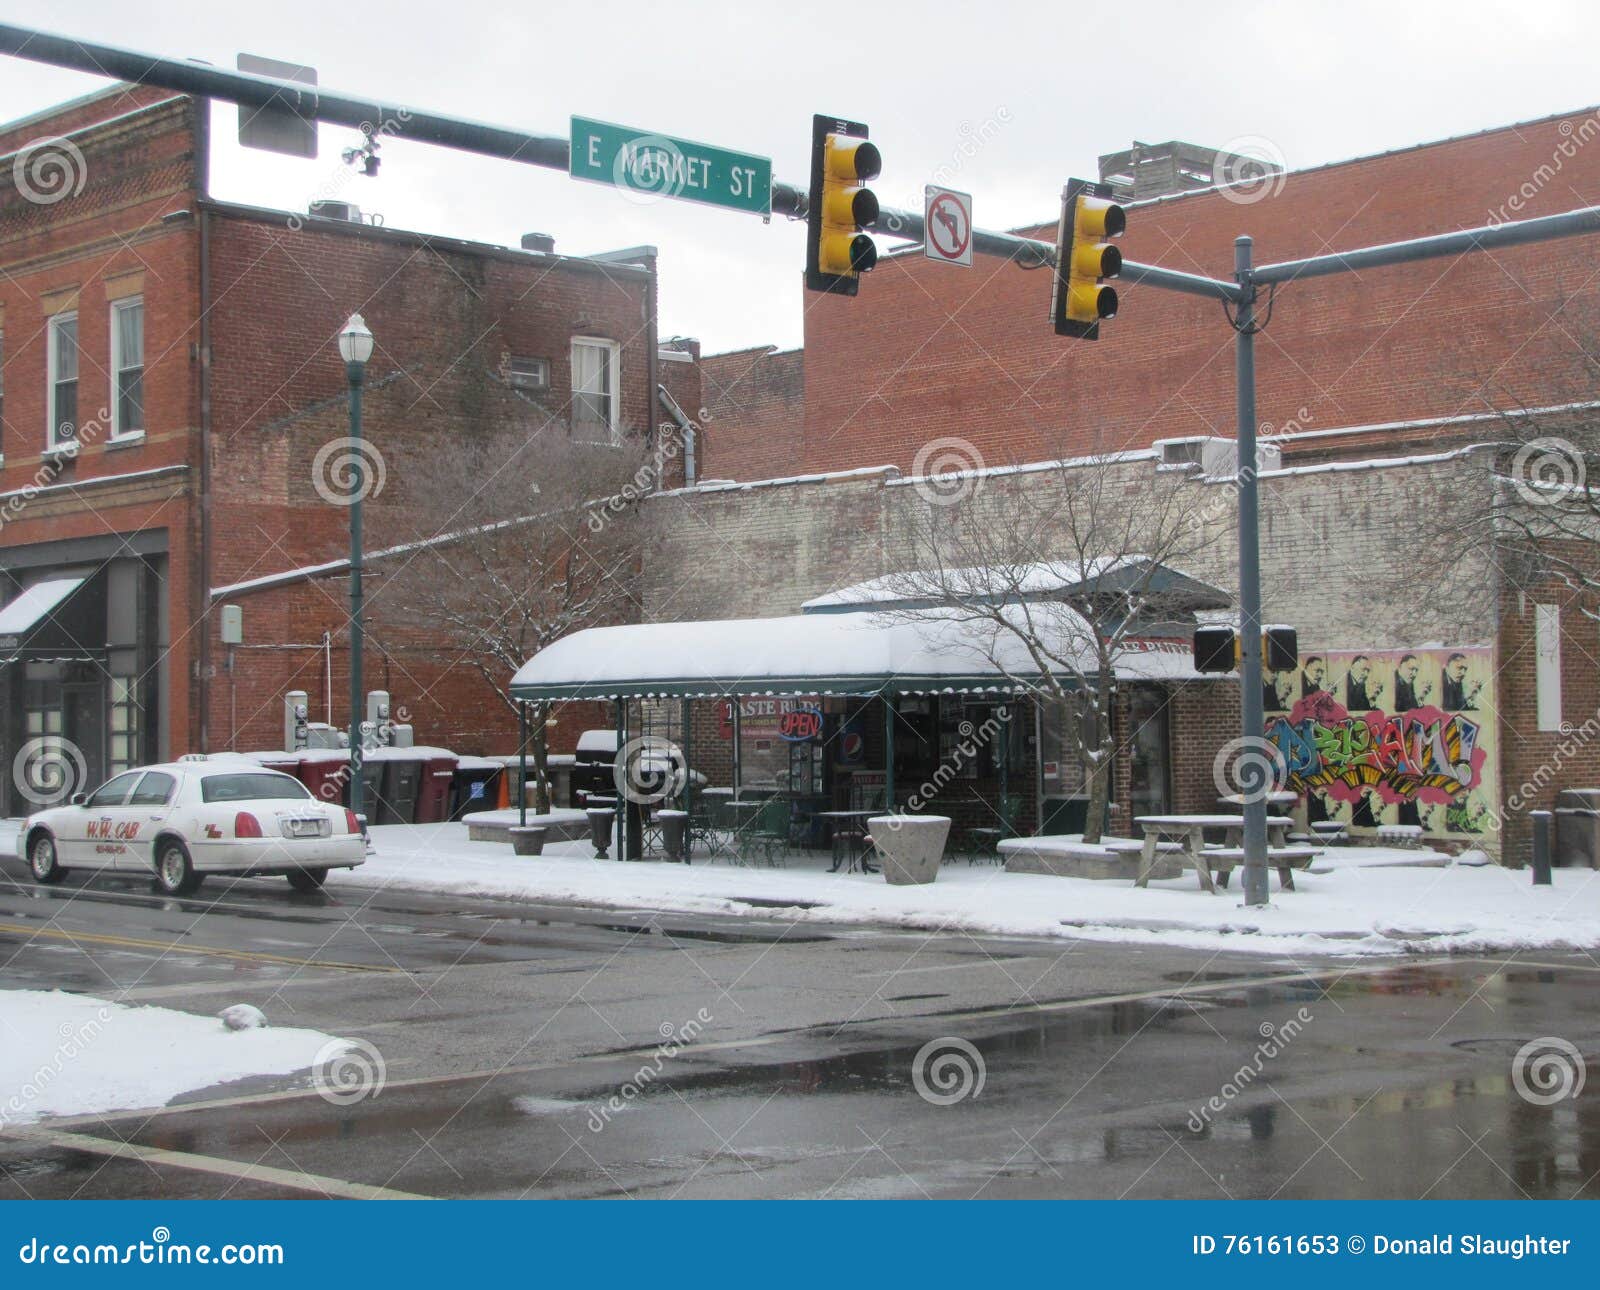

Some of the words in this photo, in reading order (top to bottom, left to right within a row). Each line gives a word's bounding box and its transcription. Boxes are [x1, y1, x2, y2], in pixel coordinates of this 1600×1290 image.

[588, 135, 602, 168] E
[620, 143, 712, 190] MARKET
[730, 166, 756, 199] ST
[778, 713, 819, 737] OPEN
[87, 821, 112, 839] W.W.
[115, 821, 141, 840] CAB
